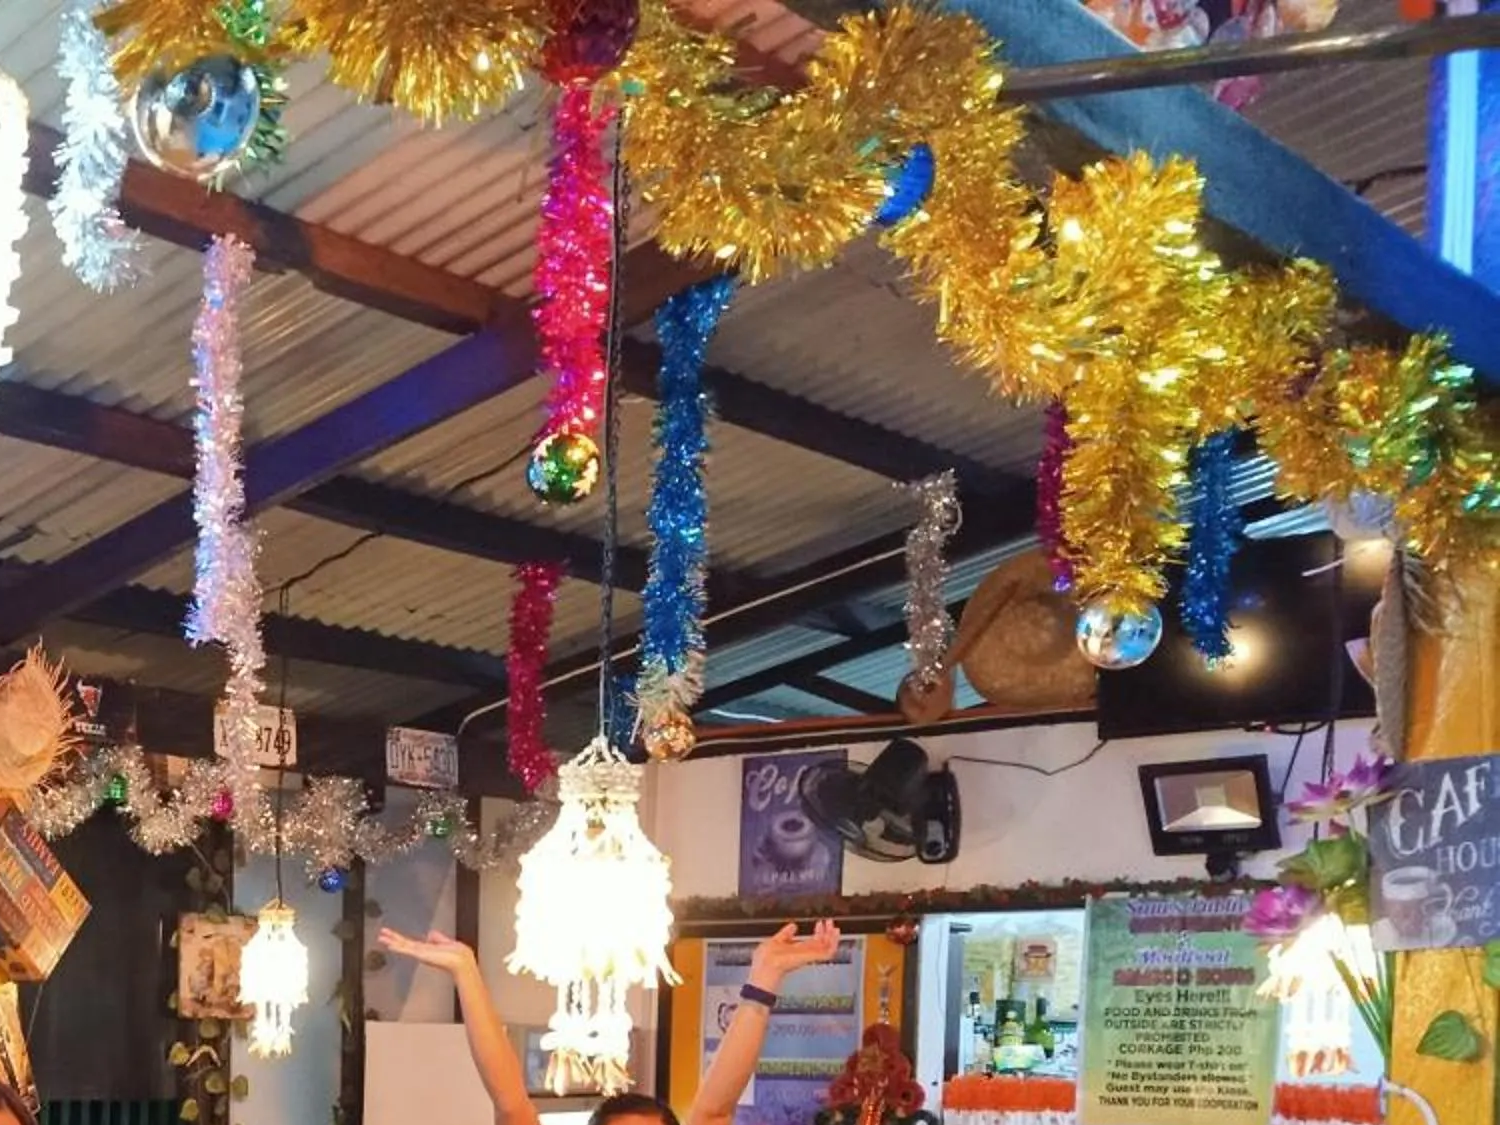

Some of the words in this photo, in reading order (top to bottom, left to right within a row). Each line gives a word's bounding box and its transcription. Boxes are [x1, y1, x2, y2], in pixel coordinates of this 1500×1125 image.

[1387, 760, 1500, 856] CAF
[1437, 837, 1500, 875] HOU
[1104, 1007, 1140, 1017] FOOD
[1144, 1008, 1169, 1017] AND
[1104, 1019, 1156, 1030] OUTSIDE
[1119, 1043, 1183, 1055] CORKAGE
[1105, 1083, 1140, 1093] Guest
[1143, 1085, 1169, 1094] may
[1099, 1096, 1129, 1107] THANK
[1131, 1096, 1150, 1107] YOU
[1152, 1097, 1171, 1107] FOR
